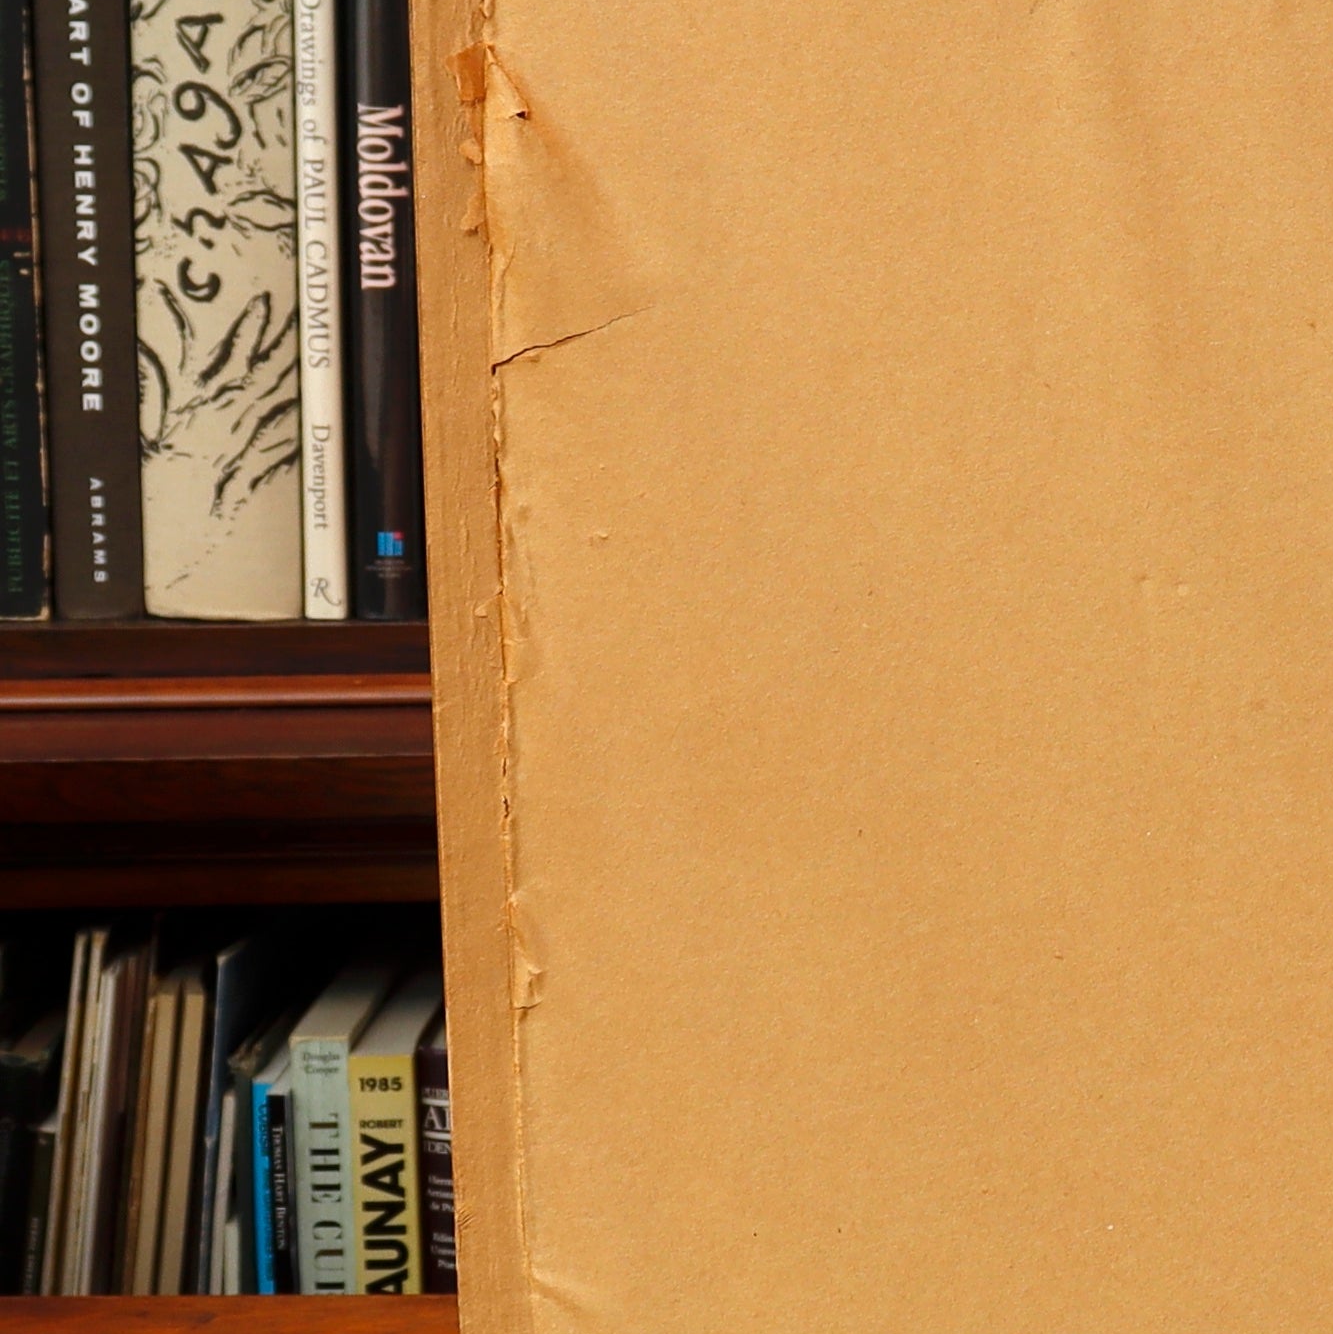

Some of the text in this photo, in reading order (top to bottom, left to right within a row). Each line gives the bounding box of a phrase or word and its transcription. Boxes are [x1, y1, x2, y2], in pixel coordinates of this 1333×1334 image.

[70, 83, 93, 128] OF
[301, 118, 328, 147] of
[73, 144, 97, 266] HENRY
[303, 157, 327, 230] PAUL
[356, 102, 408, 291] Moldovan
[78, 284, 104, 412] MOORE
[305, 238, 331, 370] CADMUS
[1, 398, 19, 450] ARTS
[307, 422, 331, 531] Davenport
[88, 477, 107, 584] ABRAMS
[310, 577, 342, 606] R
[358, 1076, 404, 1092] 1985
[358, 1118, 404, 1130] ROBERT
[271, 1124, 287, 1251] THOMAS HART BENTON
[310, 1113, 342, 1203] THE
